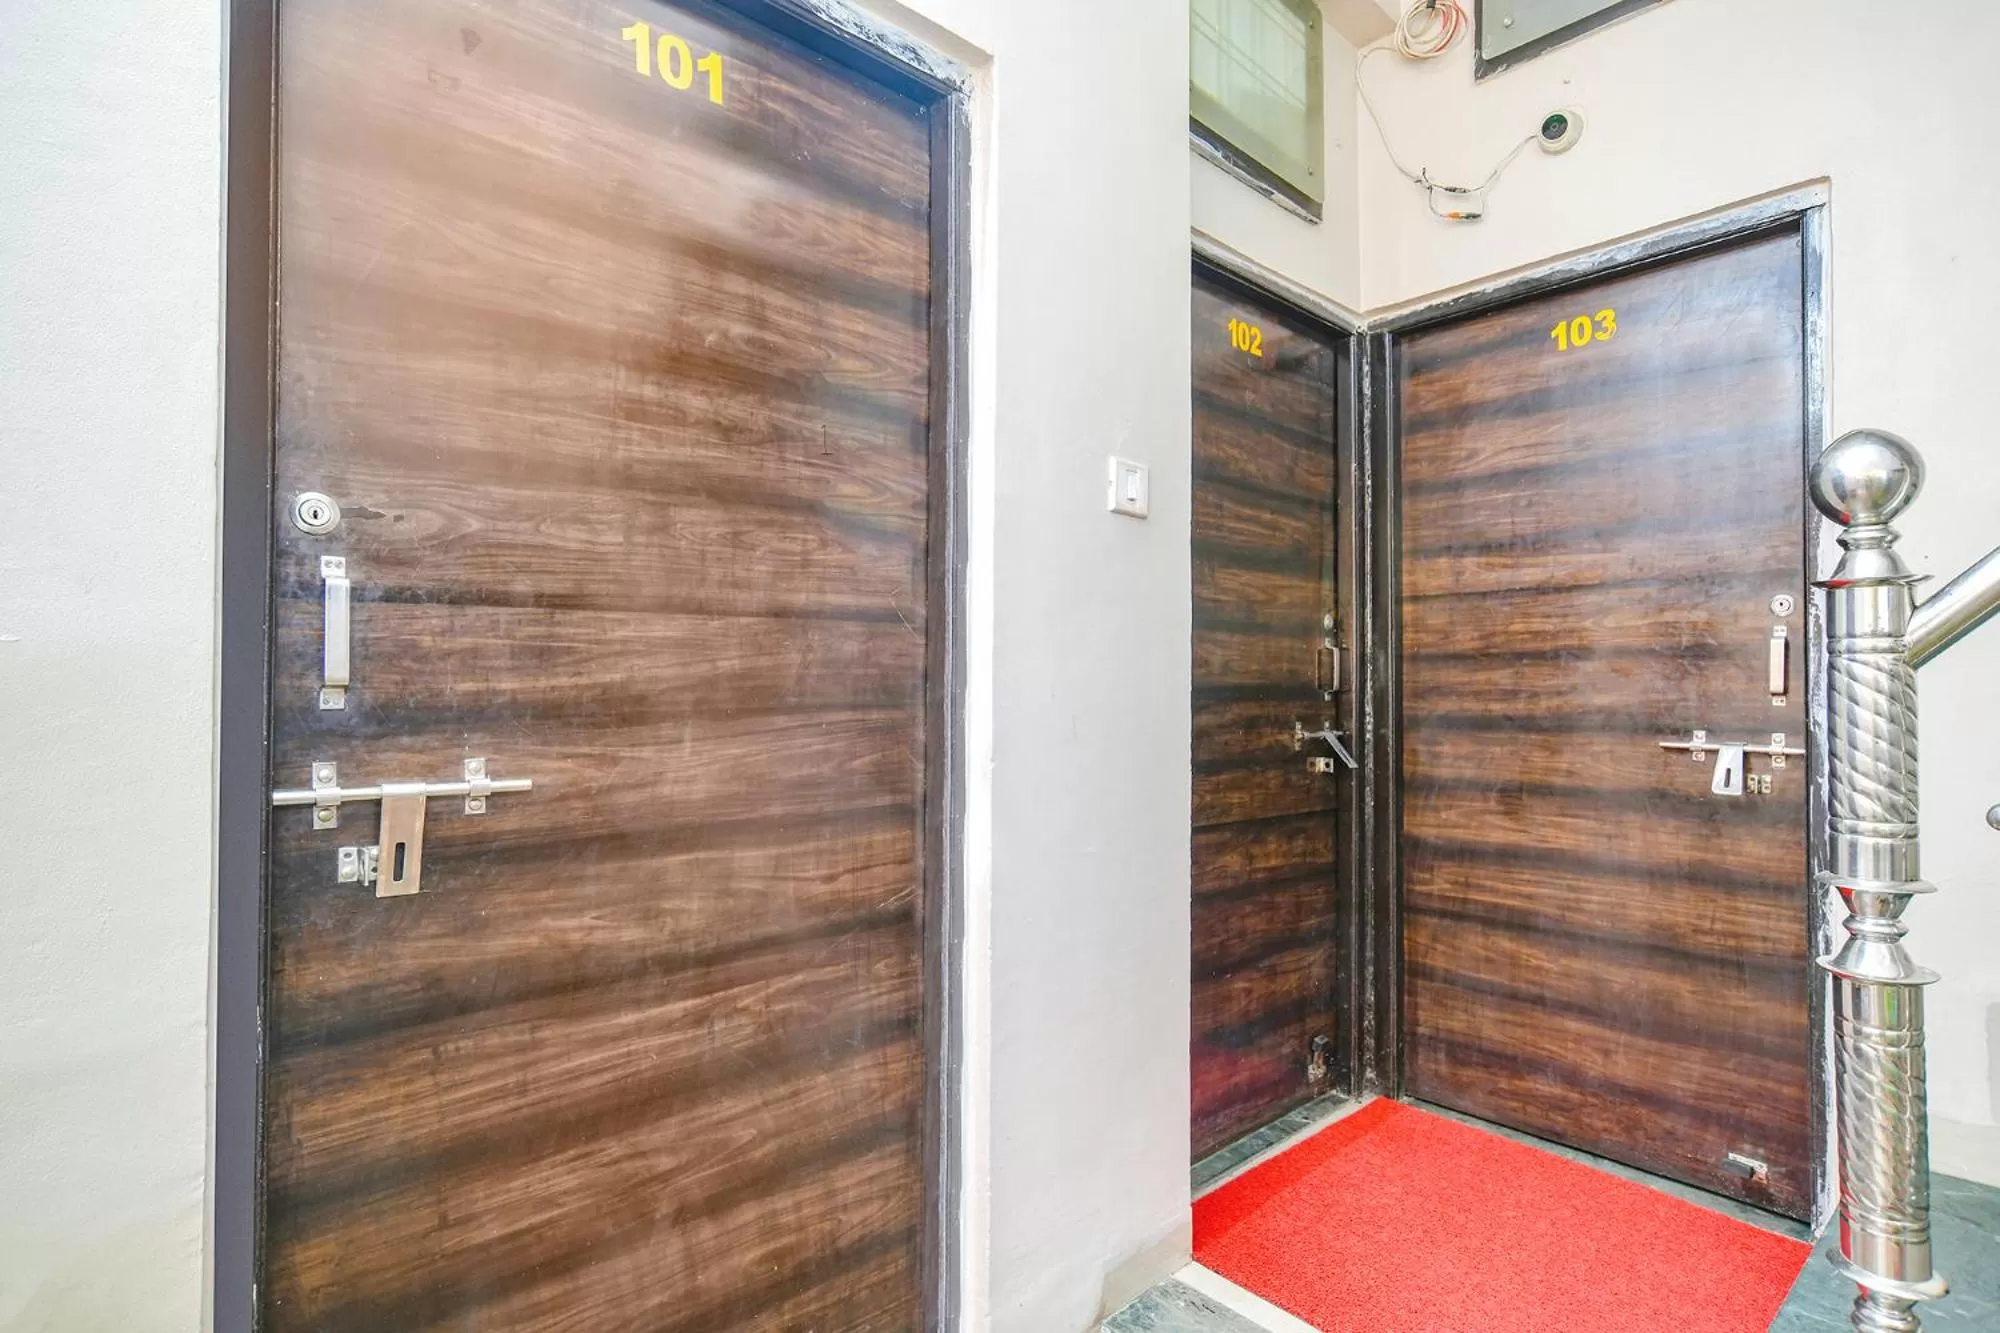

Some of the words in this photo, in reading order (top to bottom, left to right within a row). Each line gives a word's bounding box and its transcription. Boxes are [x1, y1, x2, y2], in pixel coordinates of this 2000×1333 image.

[621, 21, 723, 105] 101
[1227, 318, 1264, 358] 102
[1551, 308, 1617, 352] 103
